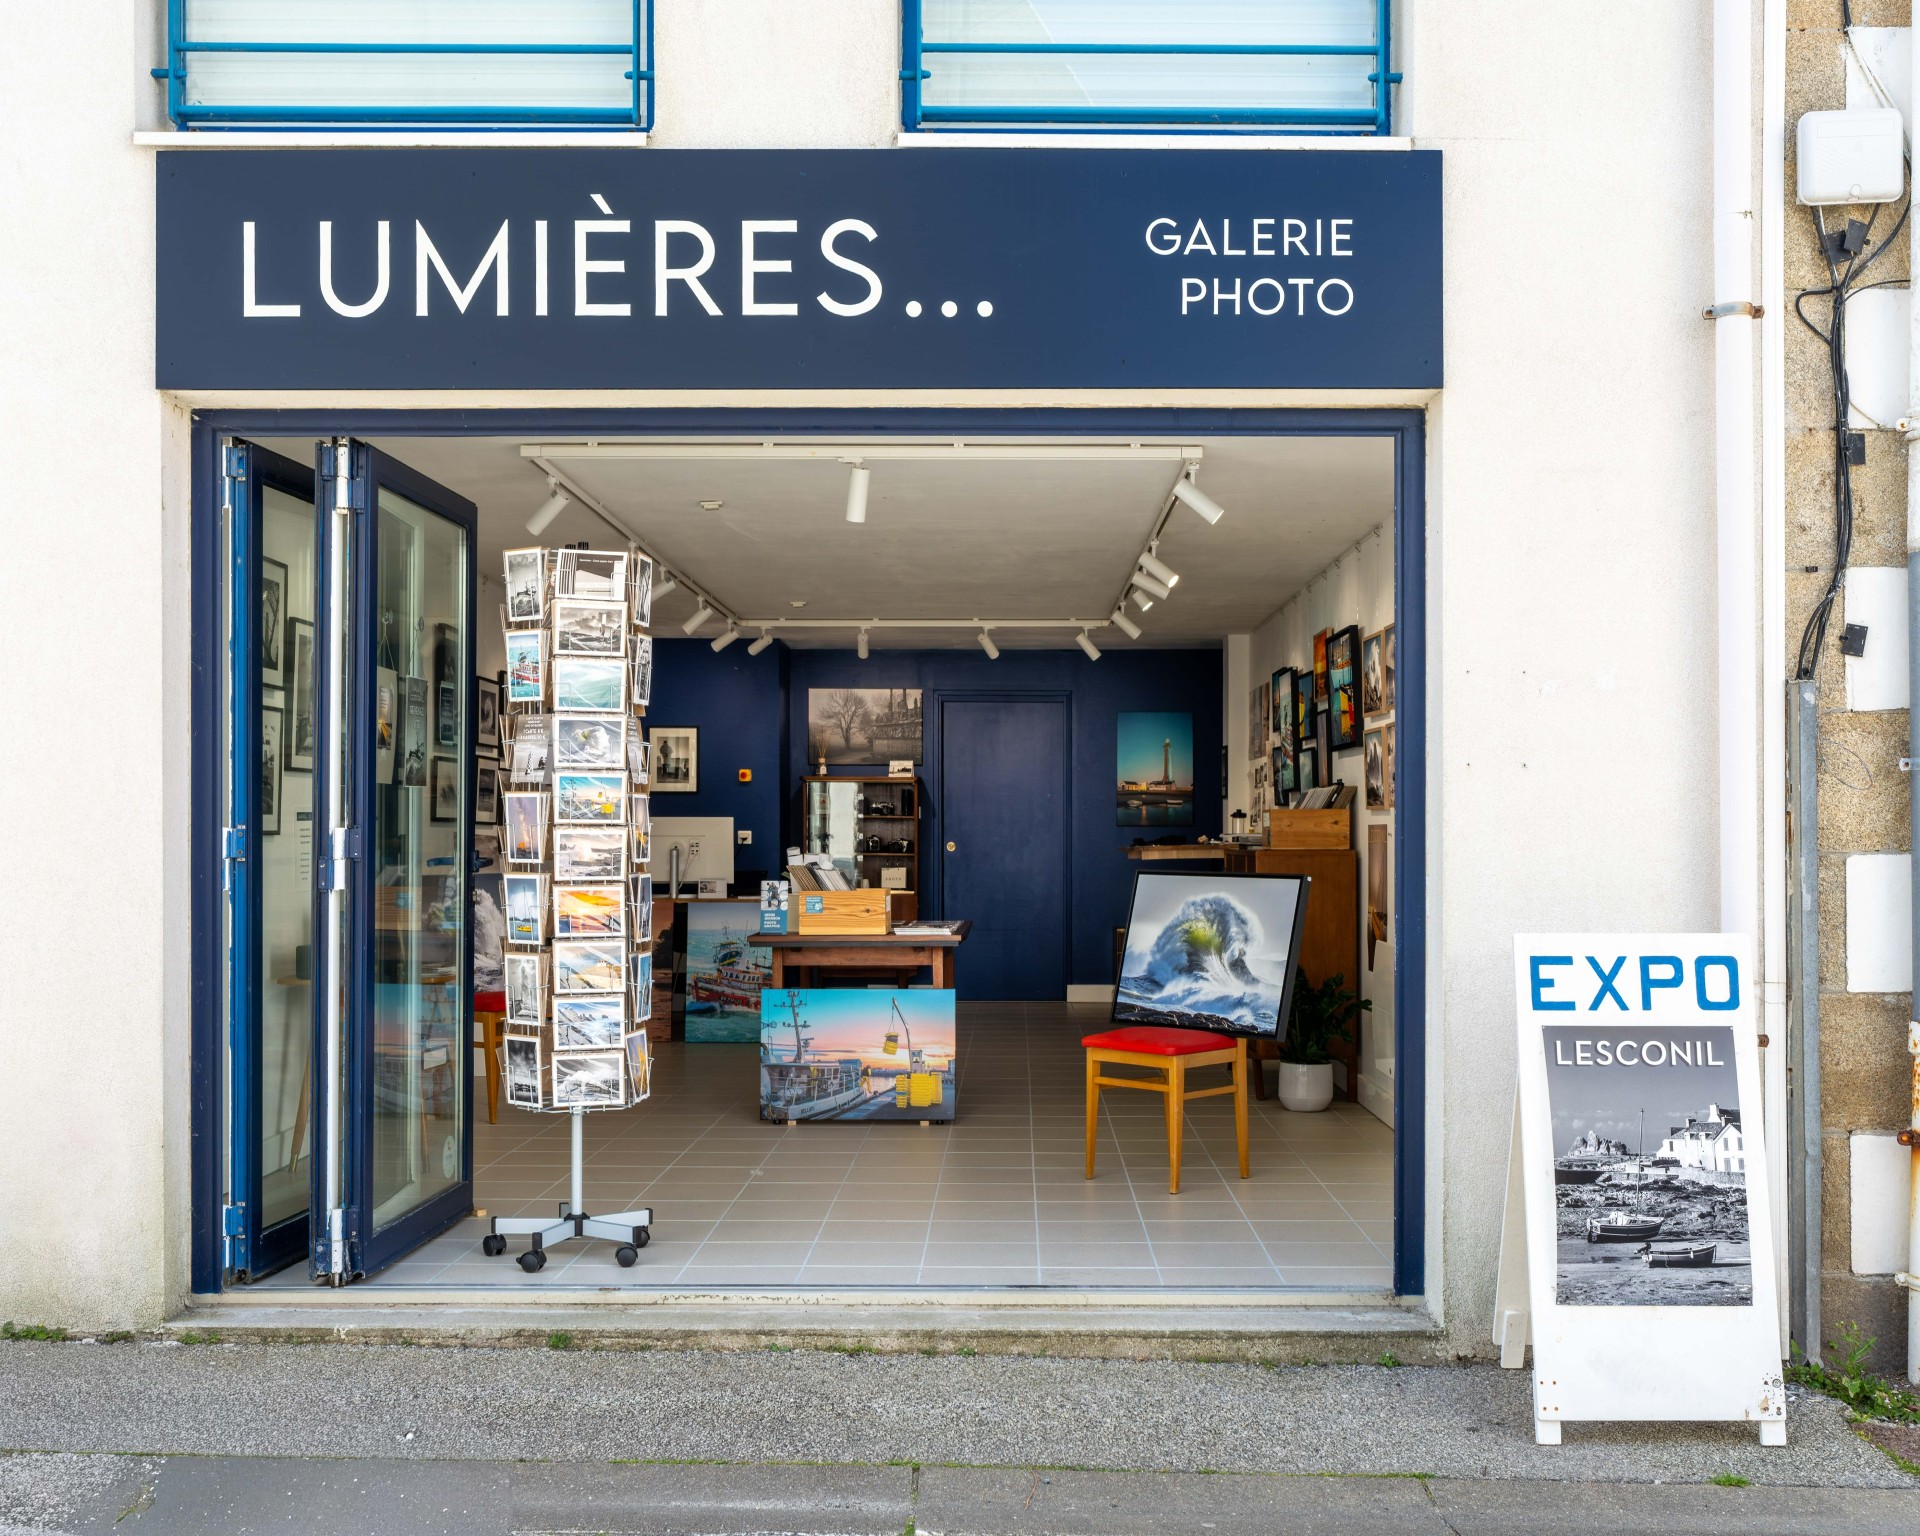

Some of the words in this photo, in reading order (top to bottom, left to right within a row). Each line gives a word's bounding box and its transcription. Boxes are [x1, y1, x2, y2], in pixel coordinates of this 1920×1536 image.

[244, 194, 994, 318] LUMIÈRES...
[1146, 217, 1353, 257] GALERIE
[1182, 277, 1354, 316] PHOTO
[1530, 955, 1741, 1011] EXPO
[1555, 1040, 1724, 1066] LESCONIL
